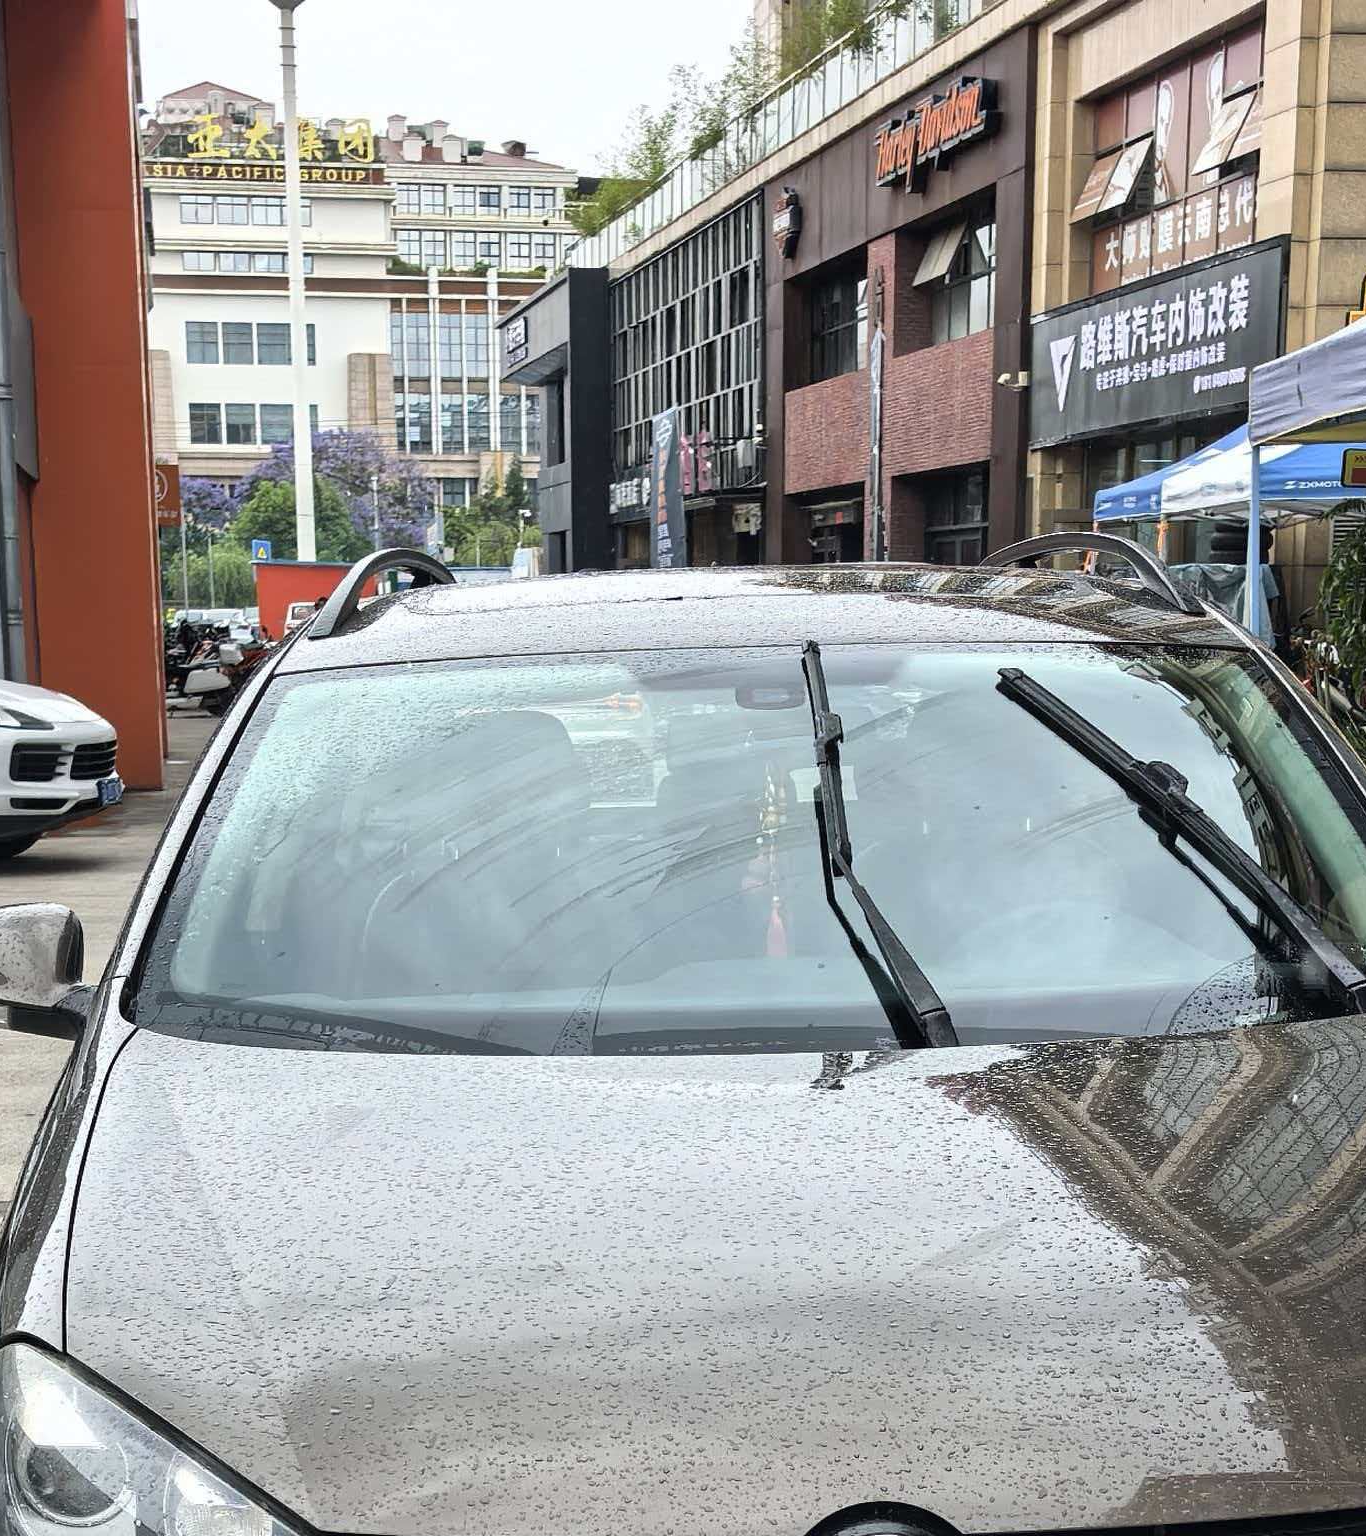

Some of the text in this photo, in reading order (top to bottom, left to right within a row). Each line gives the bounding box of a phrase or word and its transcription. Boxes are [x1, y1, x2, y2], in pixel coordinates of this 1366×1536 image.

[187, 112, 374, 163] 亚太集团
[299, 168, 366, 182] GROUP
